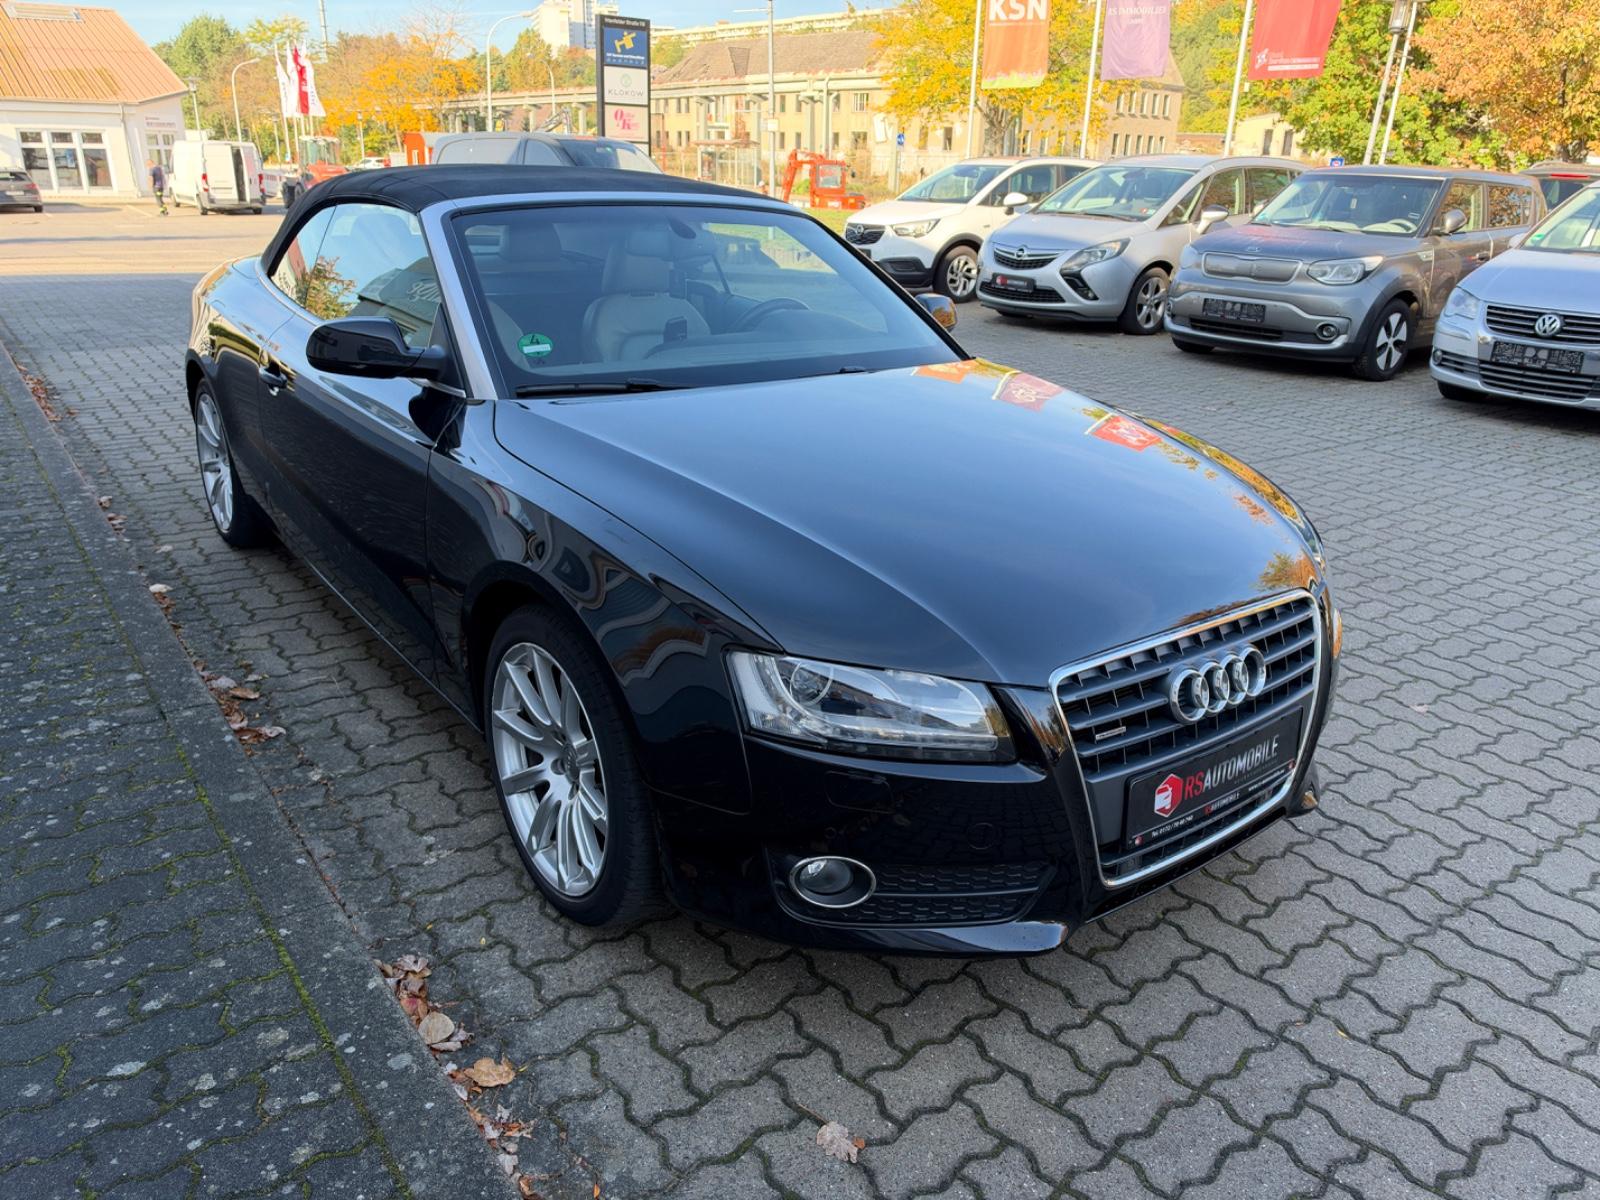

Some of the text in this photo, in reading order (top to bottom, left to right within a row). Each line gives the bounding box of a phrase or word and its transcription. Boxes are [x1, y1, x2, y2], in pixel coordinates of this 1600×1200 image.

[989, 0, 1047, 21] KSN
[608, 88, 643, 97] KLOKOW
[530, 334, 540, 345] 4
[1184, 734, 1279, 801] RSAUTOMOBILE
